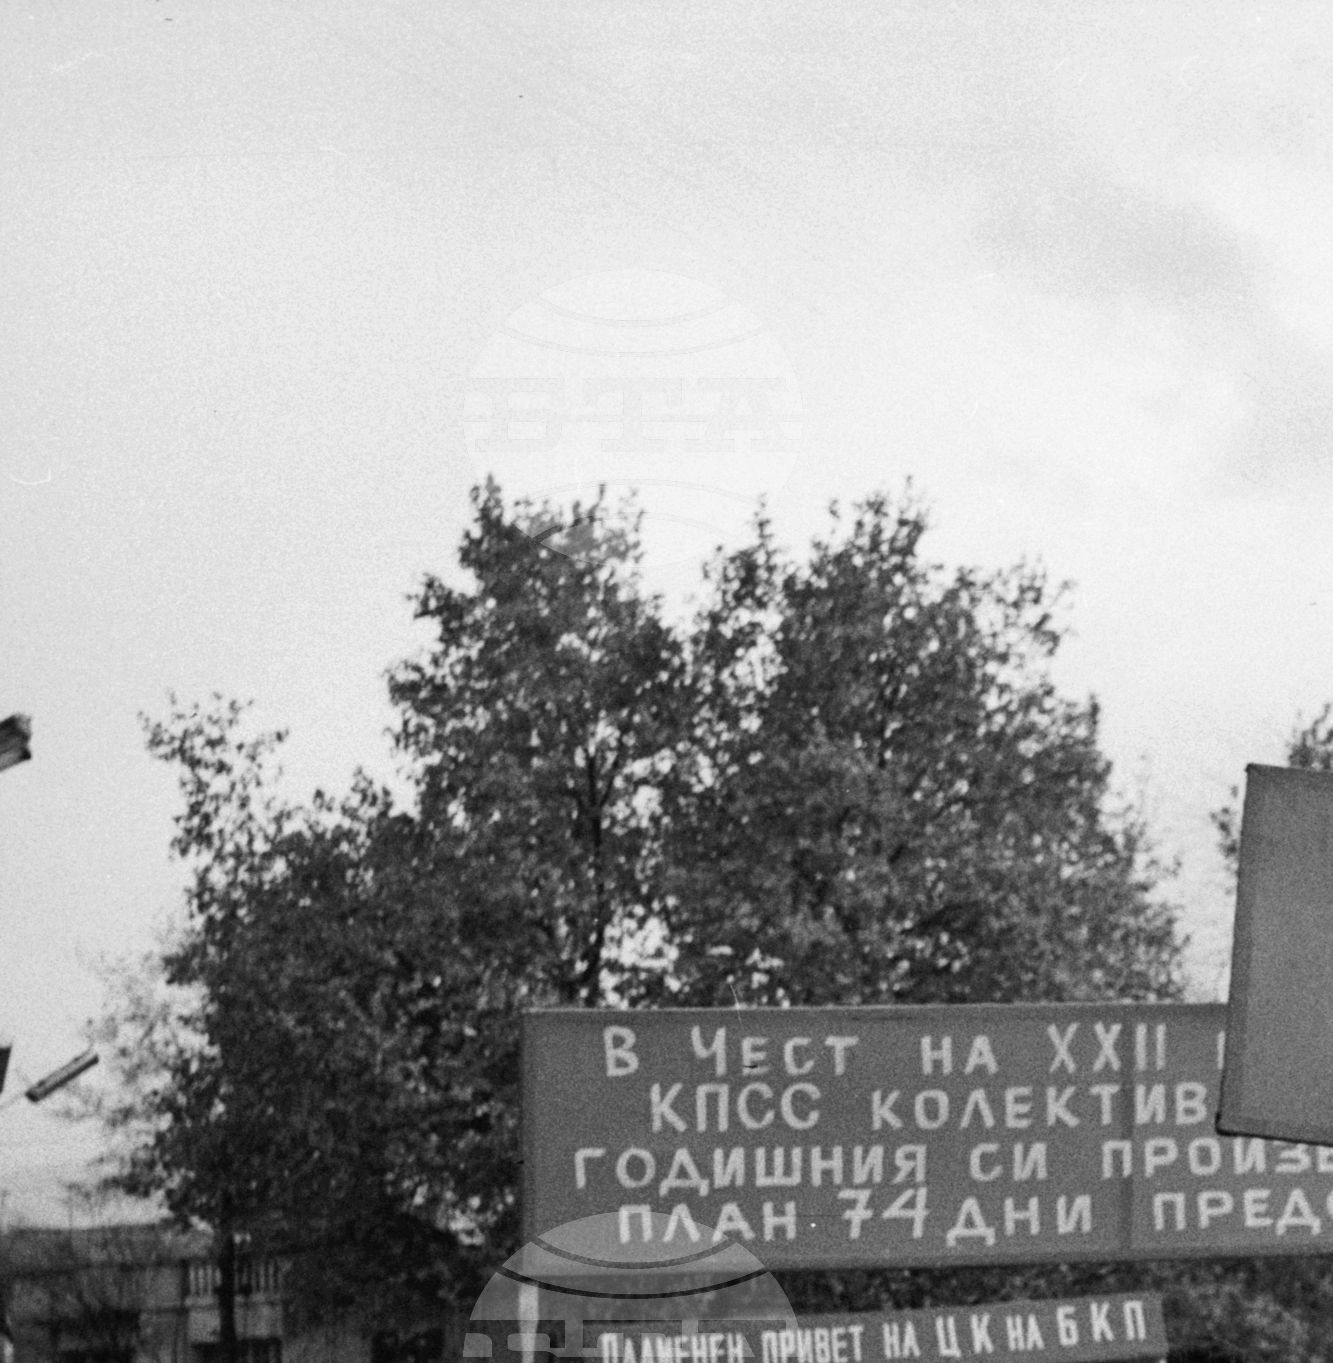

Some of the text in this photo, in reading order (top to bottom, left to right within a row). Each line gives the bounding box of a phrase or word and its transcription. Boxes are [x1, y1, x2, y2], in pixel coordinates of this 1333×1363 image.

[603, 1025, 640, 1077] В
[690, 1026, 859, 1076] ЧЕСТ
[919, 1034, 999, 1075] НА
[649, 1081, 822, 1133] КПСС
[573, 1144, 928, 1197] ГОДИШНИЯ
[969, 1141, 1049, 1182] СИ
[618, 1200, 798, 1244] ПЛАН
[837, 1187, 931, 1240] 74
[946, 1194, 1093, 1247] ДНИ
[883, 1320, 921, 1359] НА
[1006, 1313, 1046, 1351] НА
[1056, 1299, 1147, 1347] БКП
